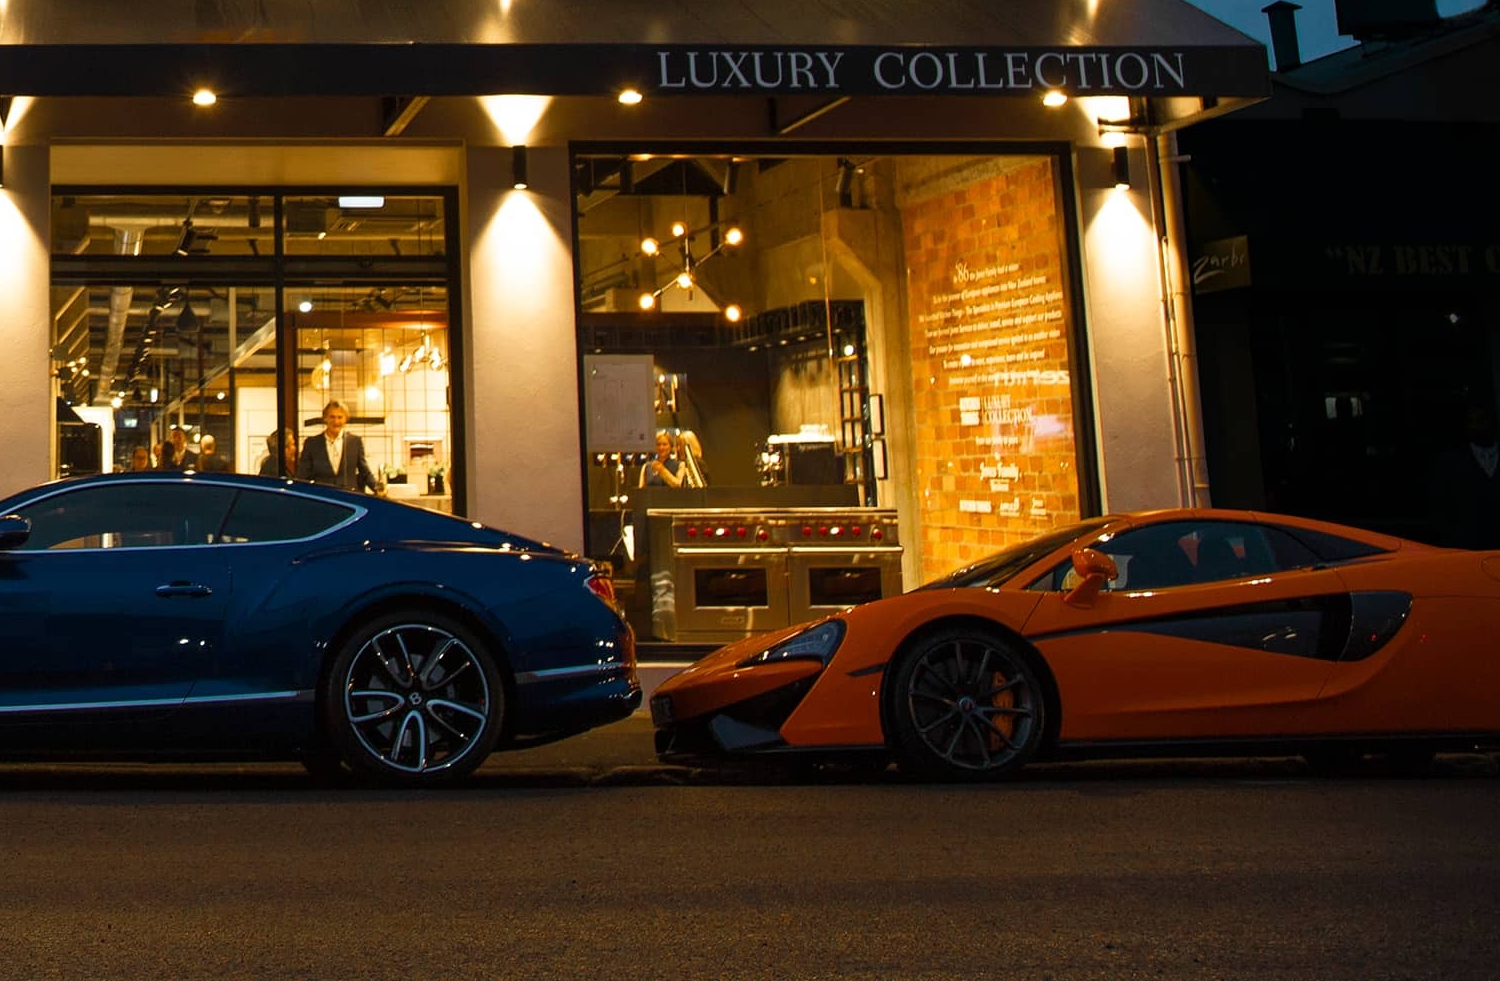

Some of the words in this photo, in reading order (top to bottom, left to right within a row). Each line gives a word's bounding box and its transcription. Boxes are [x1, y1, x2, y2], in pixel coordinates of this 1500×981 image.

[657, 52, 844, 88] LUXURY
[874, 53, 1185, 90] COLLECTION
[1392, 244, 1475, 276] BEST
